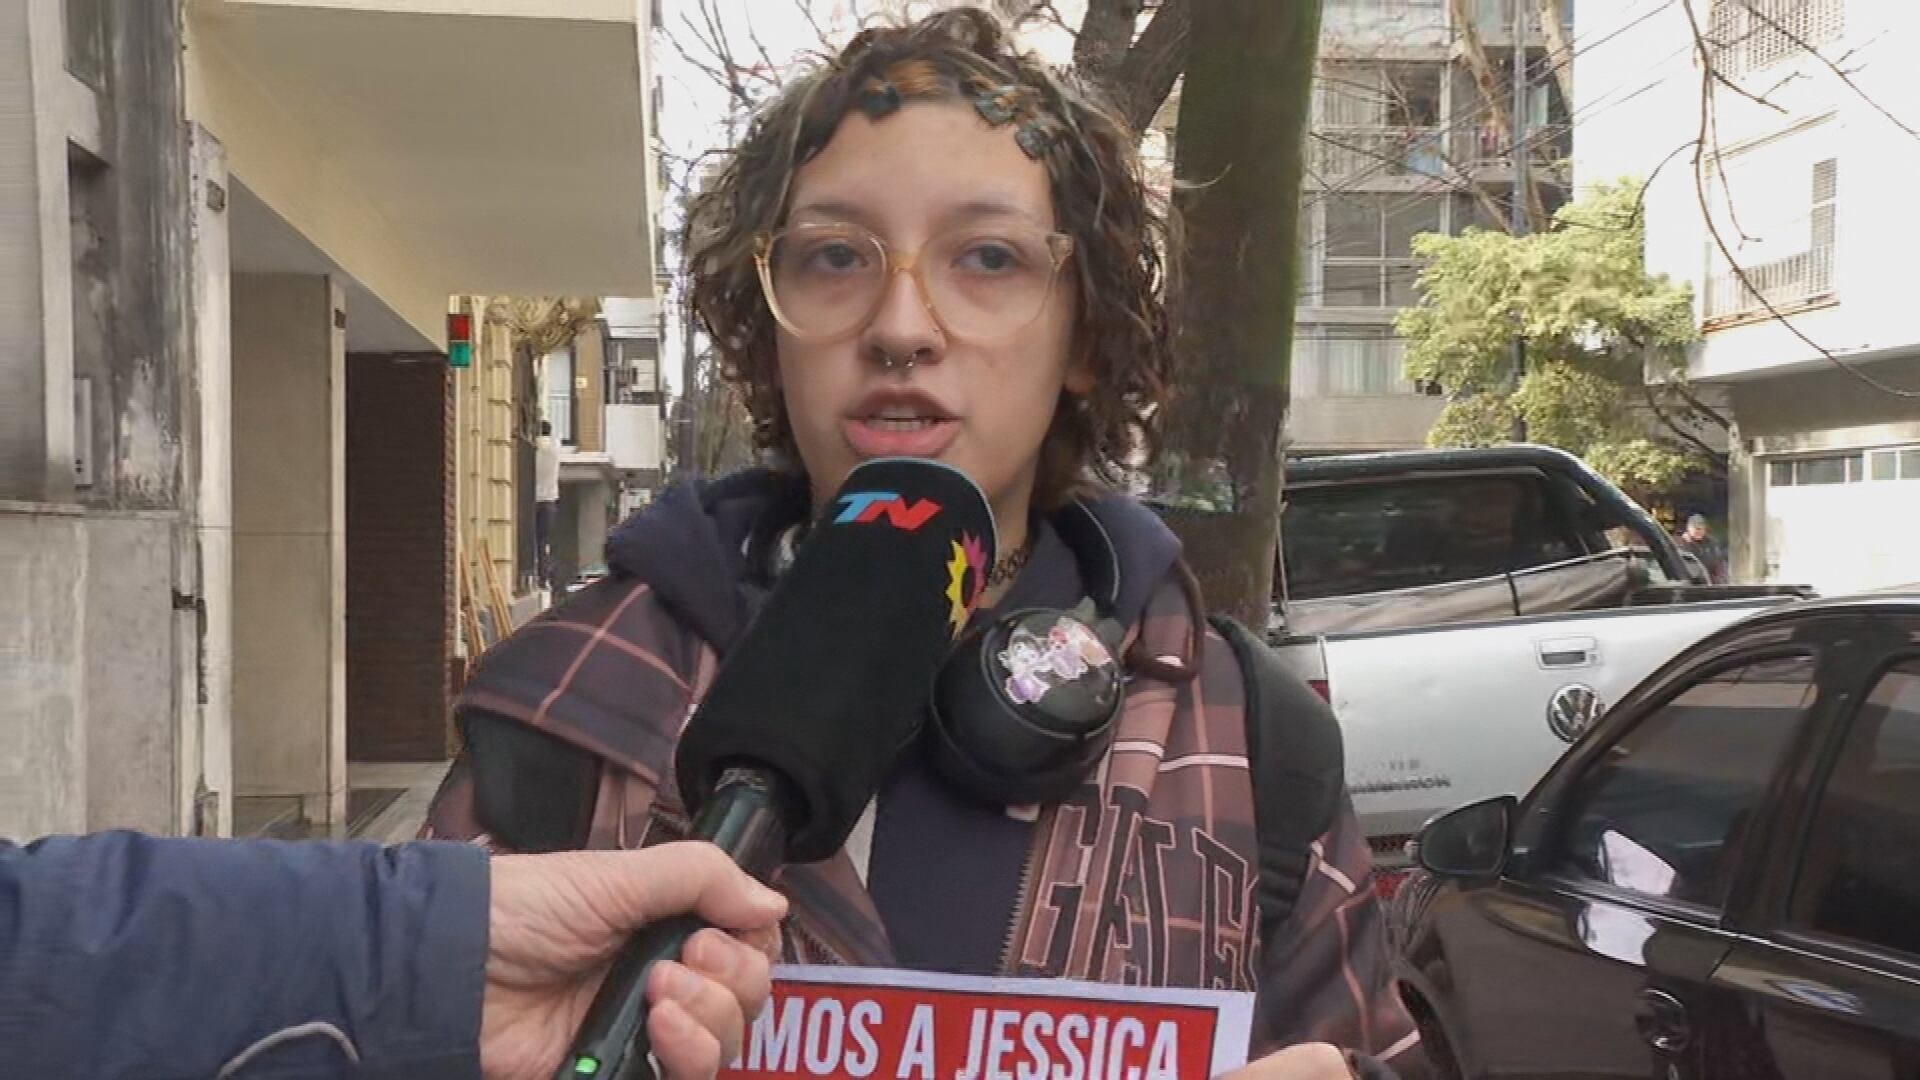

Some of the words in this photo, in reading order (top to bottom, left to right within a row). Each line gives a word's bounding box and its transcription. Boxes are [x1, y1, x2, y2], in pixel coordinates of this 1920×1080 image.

[833, 491, 944, 531] TN
[730, 995, 884, 1077] MOS
[896, 1003, 936, 1080] A
[954, 1007, 1179, 1080] JESSICA
